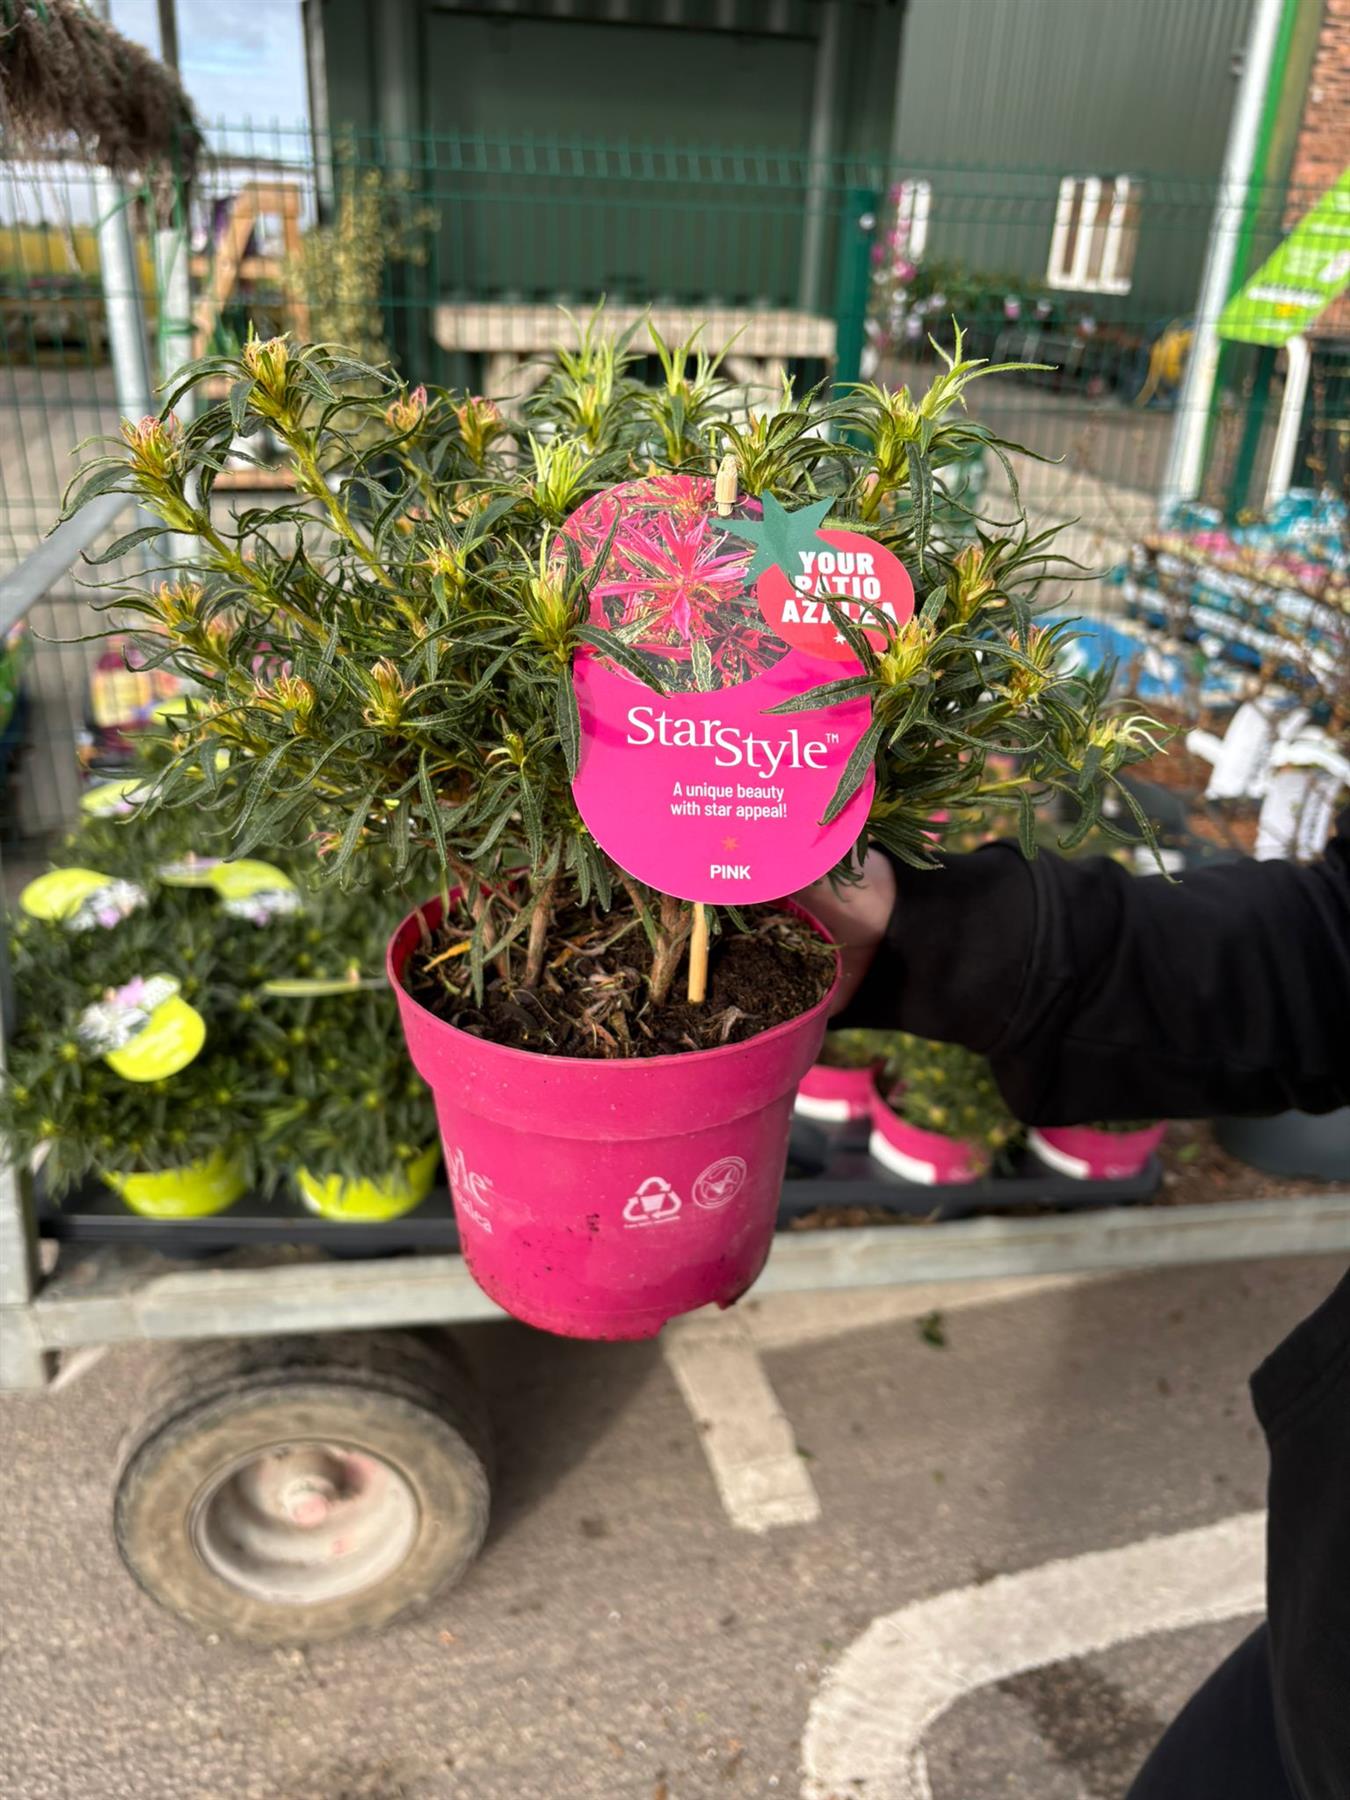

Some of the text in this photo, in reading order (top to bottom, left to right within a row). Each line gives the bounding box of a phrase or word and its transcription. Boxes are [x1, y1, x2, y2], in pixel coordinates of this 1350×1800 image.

[798, 551, 875, 575] YOUR
[794, 575, 881, 600] PATIO
[672, 781, 784, 802] A unique beauty
[670, 801, 788, 821] with star appeal!
[709, 865, 751, 879] PINK
